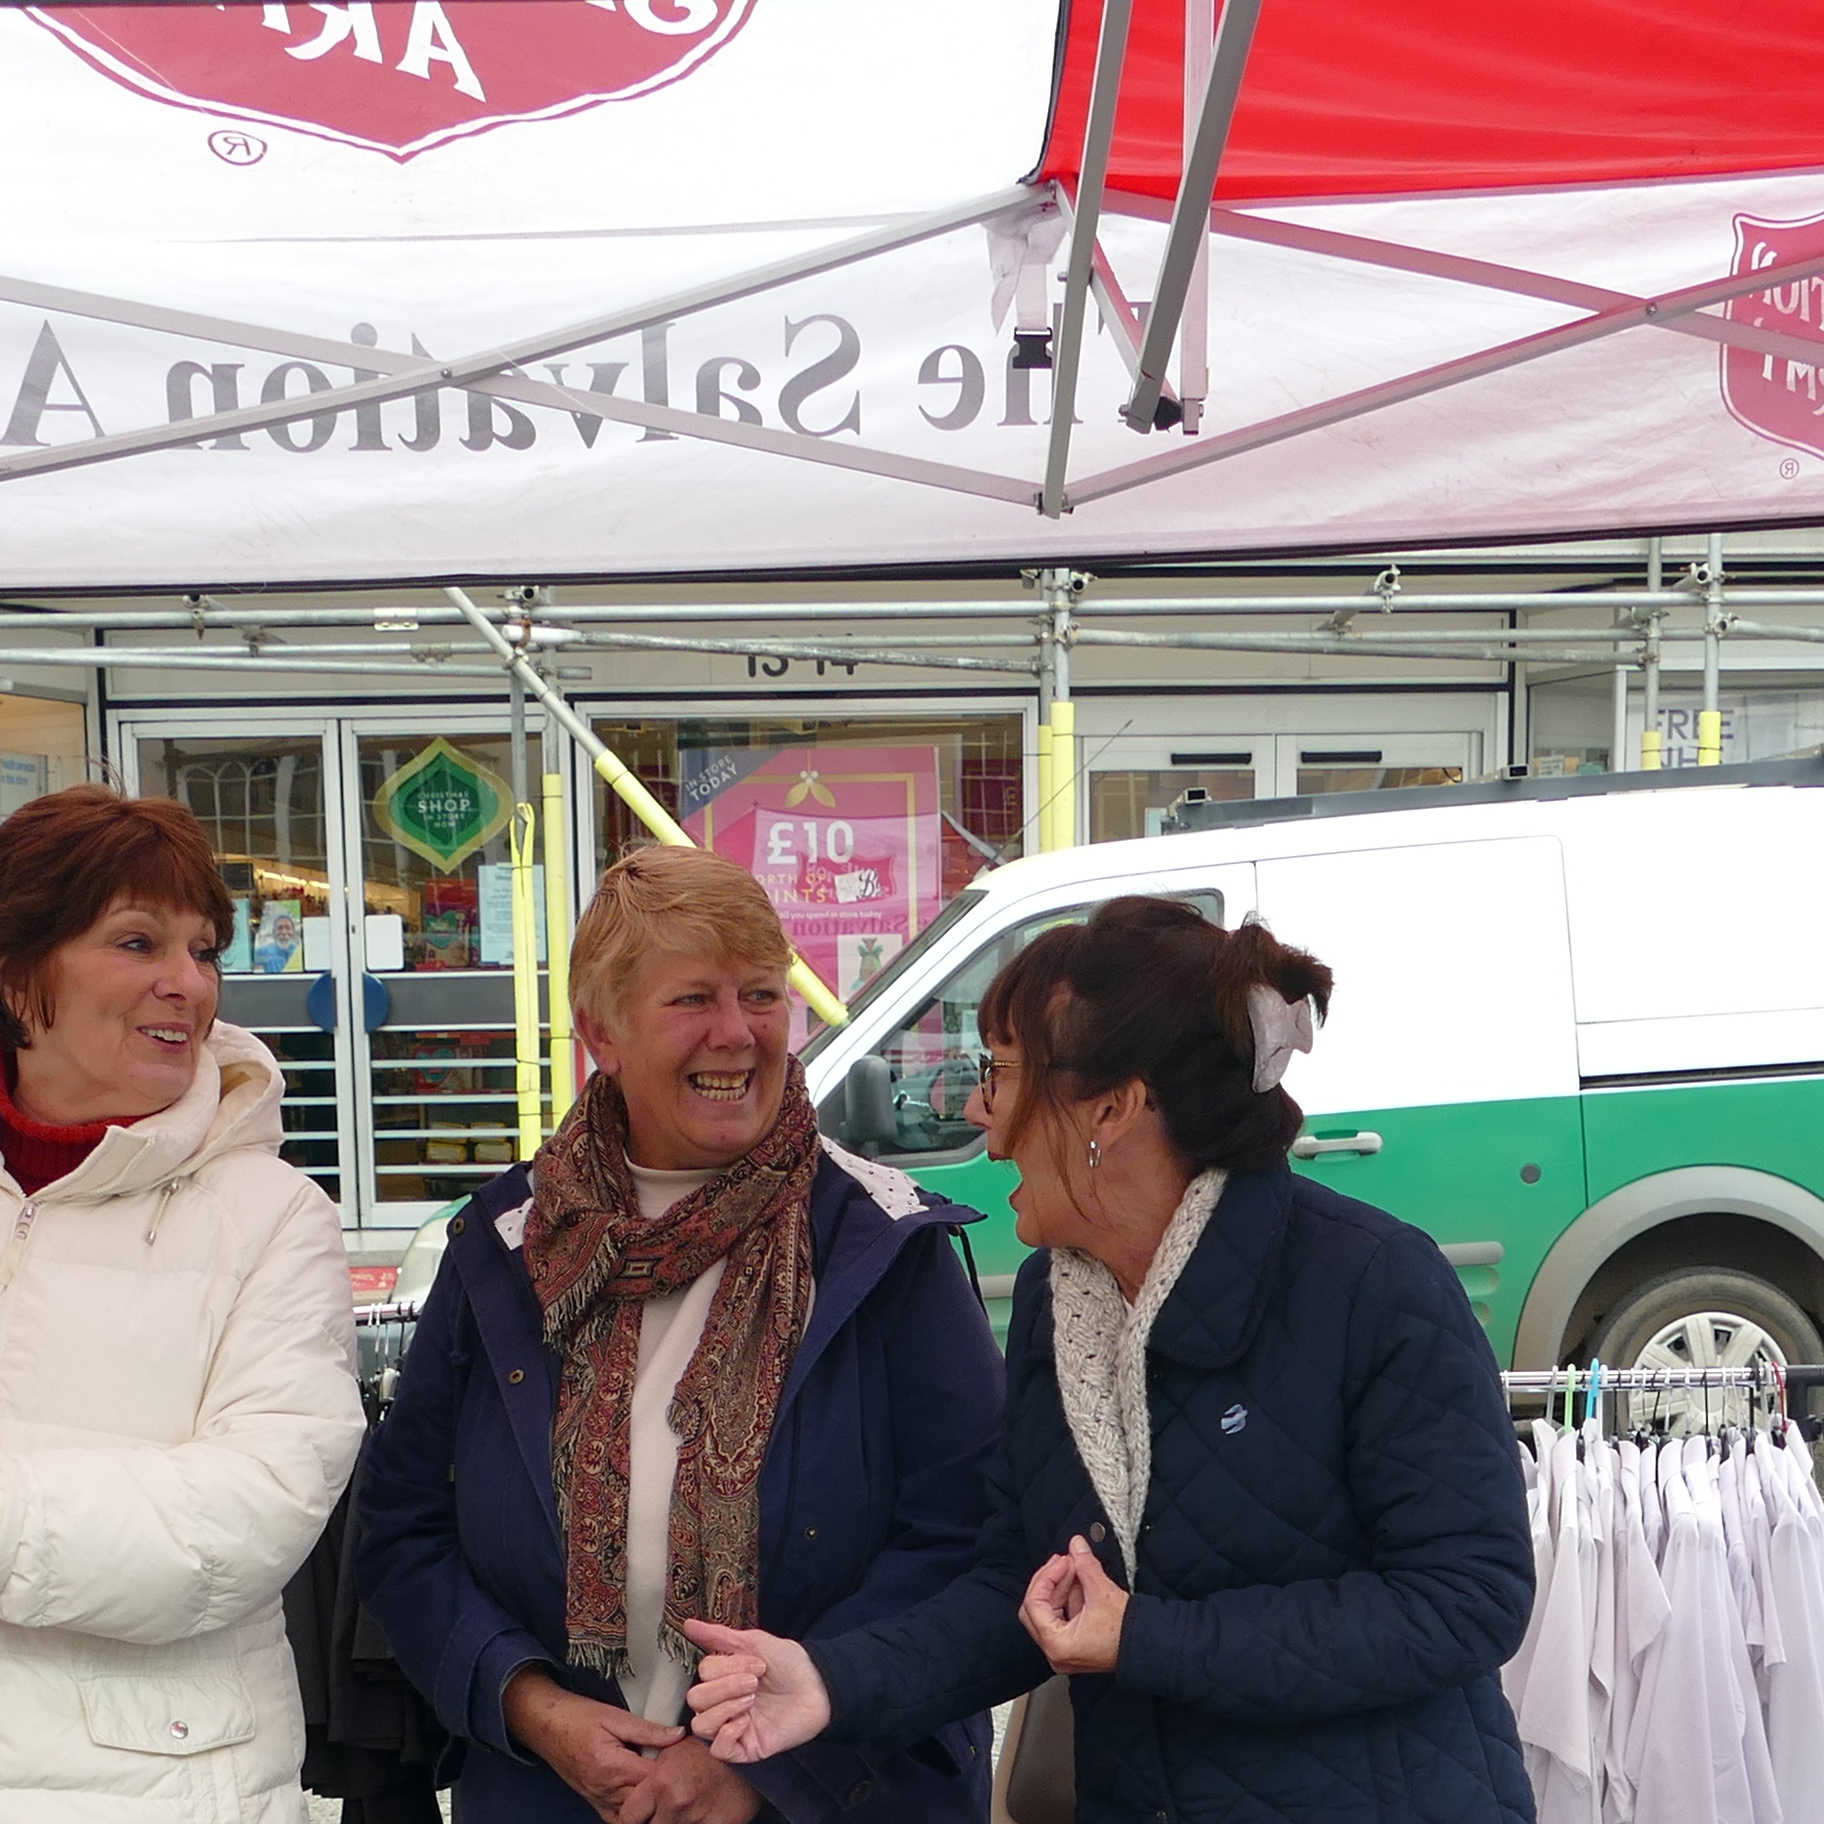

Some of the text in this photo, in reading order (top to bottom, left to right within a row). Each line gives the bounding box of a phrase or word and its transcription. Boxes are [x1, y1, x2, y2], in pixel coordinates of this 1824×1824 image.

[689, 764, 738, 802] TODAY
[418, 798, 470, 813] SHOP
[767, 820, 855, 865] £10
[758, 873, 797, 885] ORTH
[766, 887, 827, 903] INTS
